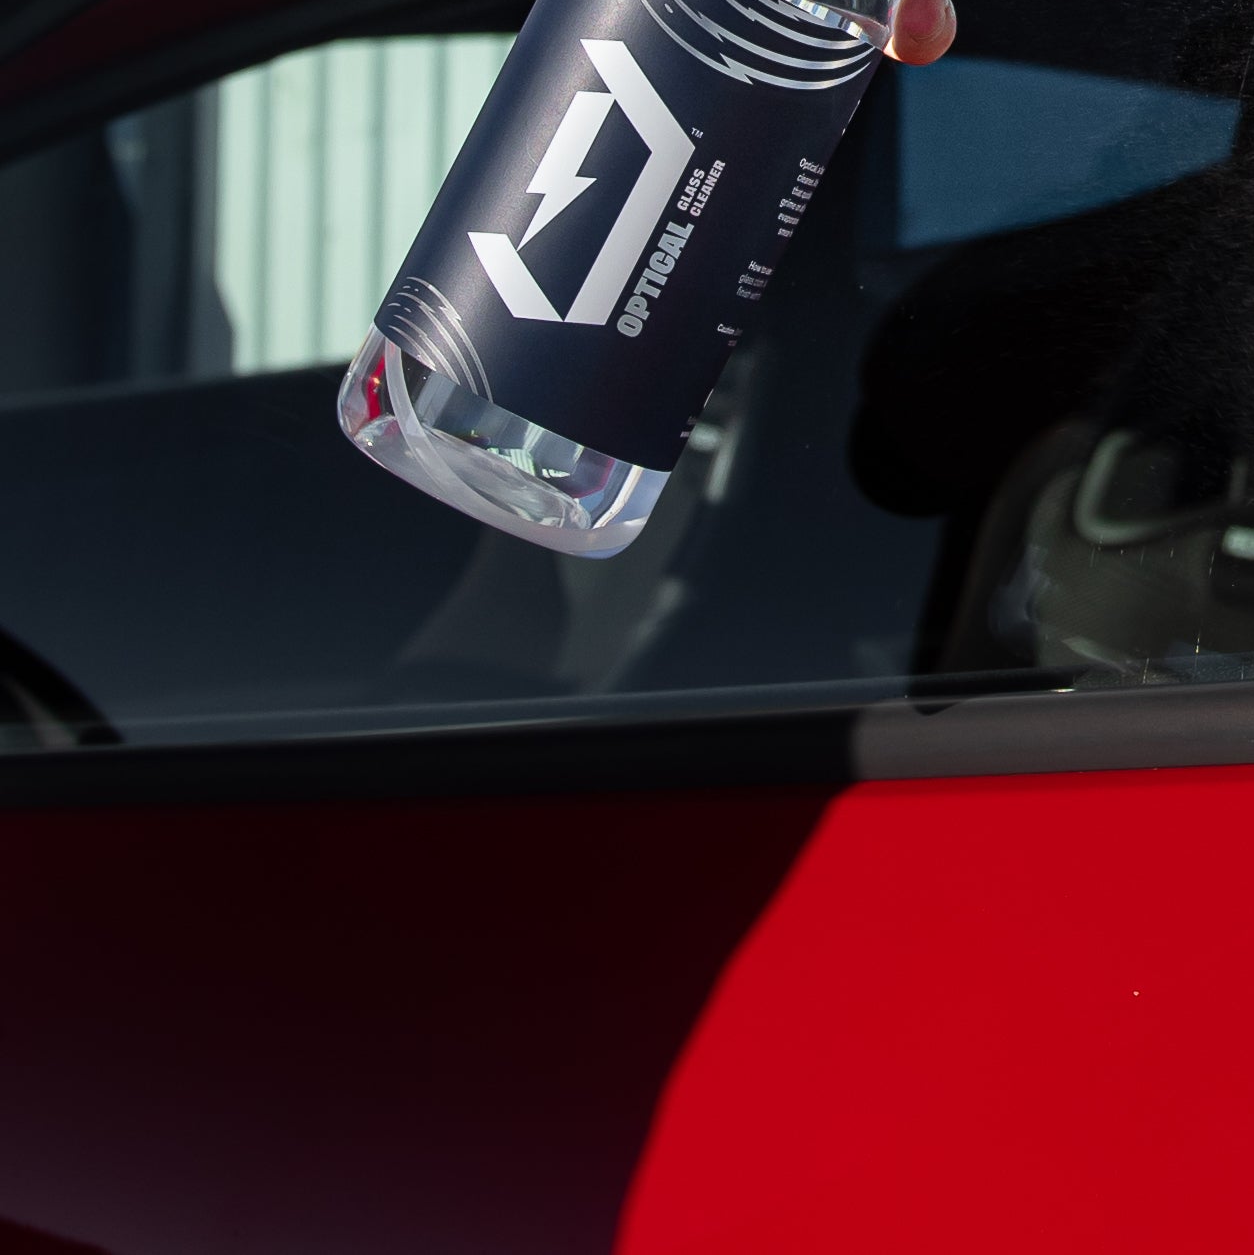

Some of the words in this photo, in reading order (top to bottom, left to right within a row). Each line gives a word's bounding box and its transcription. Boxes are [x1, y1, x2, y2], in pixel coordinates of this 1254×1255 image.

[677, 168, 705, 211] GLASS
[689, 159, 726, 217] CLEANER
[616, 221, 695, 338] OPTICAL
